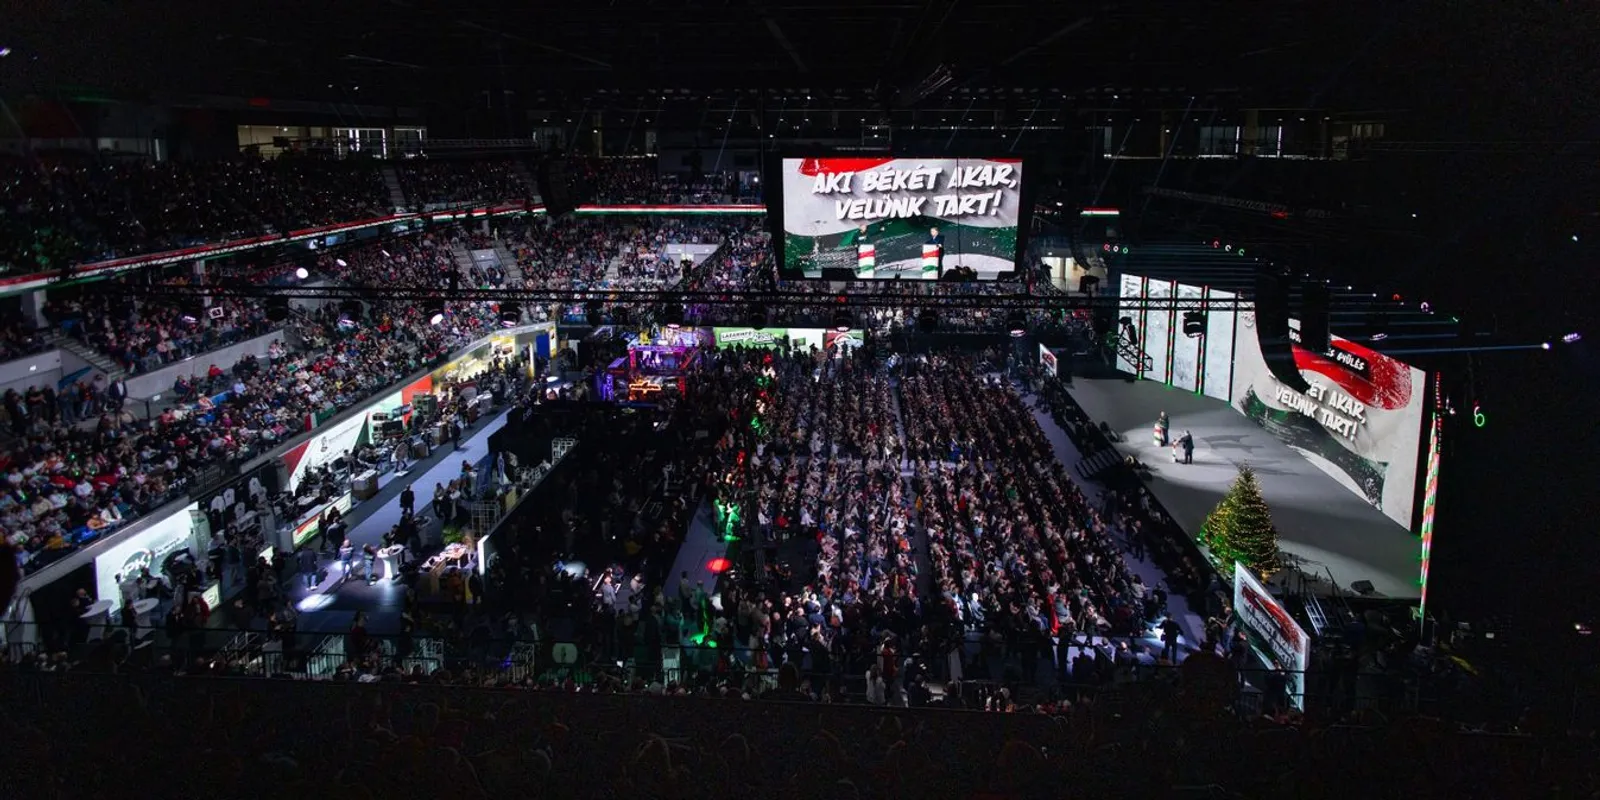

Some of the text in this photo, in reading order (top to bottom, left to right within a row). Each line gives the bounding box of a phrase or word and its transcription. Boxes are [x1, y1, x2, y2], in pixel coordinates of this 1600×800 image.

[812, 164, 1018, 194] AKI BÉKÉT AKAR,
[933, 190, 1003, 216] TART!
[1321, 406, 1358, 441] TART!
[1329, 391, 1367, 425] AKAR,
